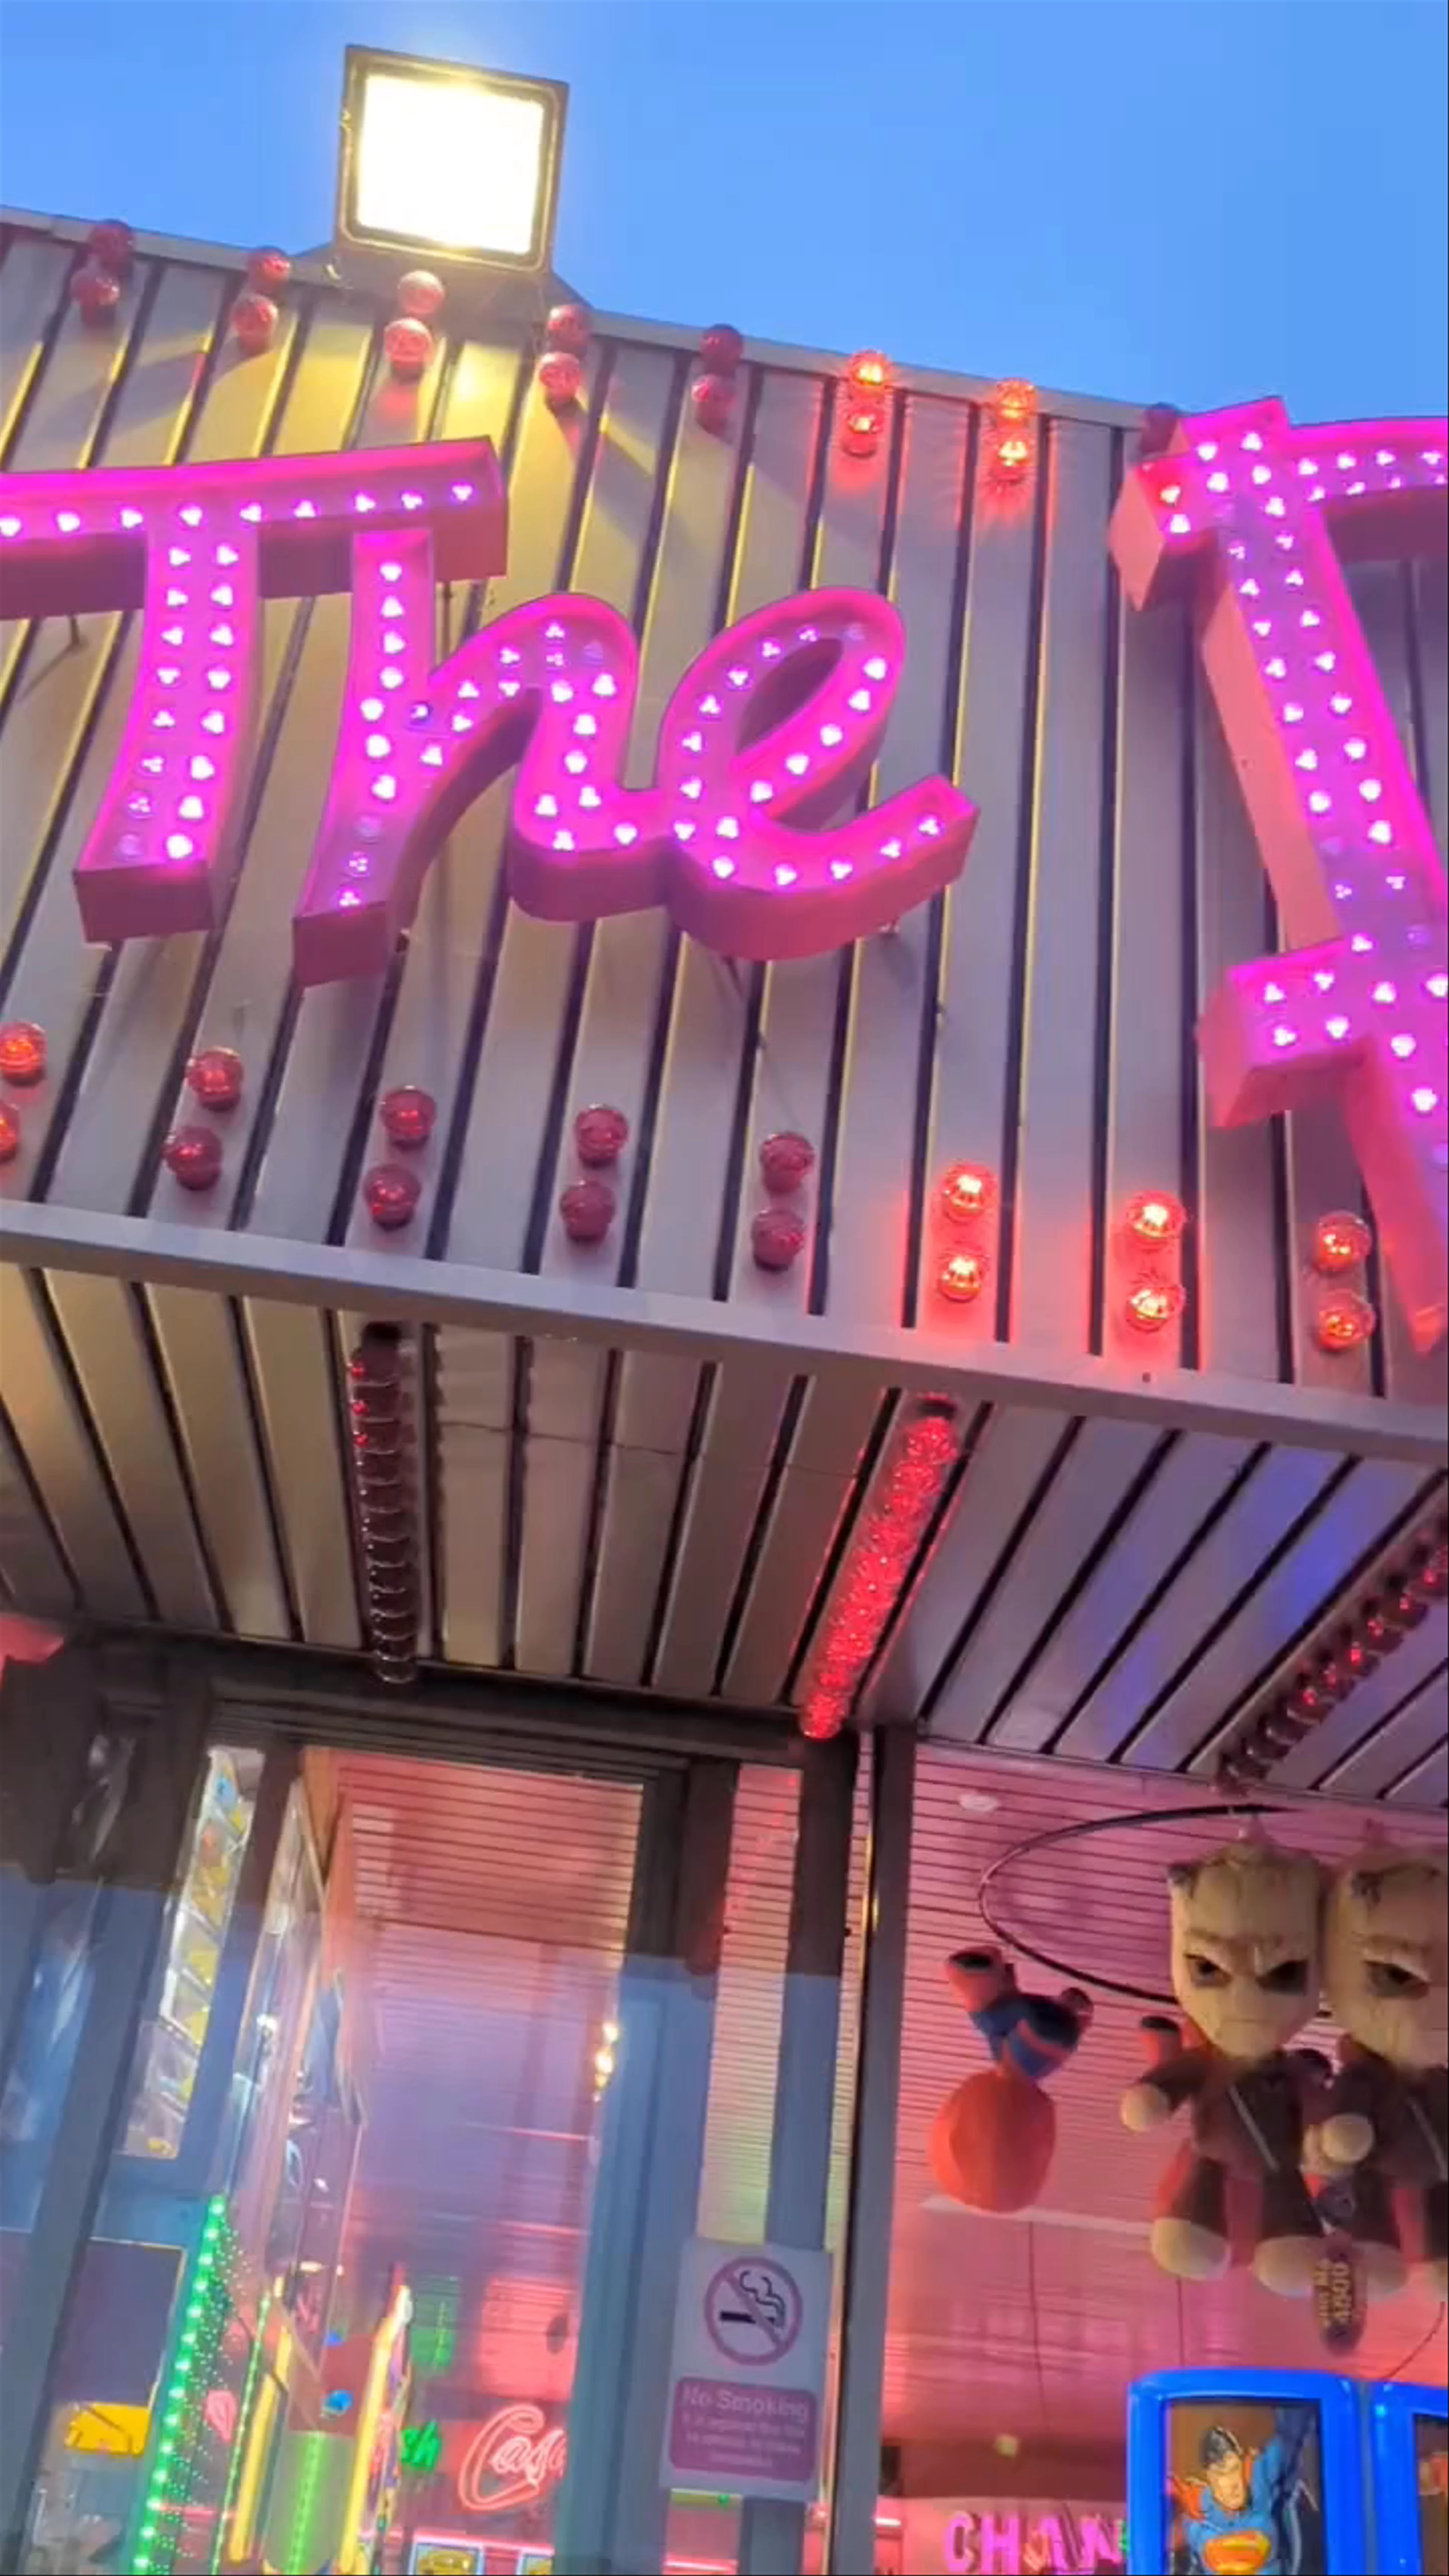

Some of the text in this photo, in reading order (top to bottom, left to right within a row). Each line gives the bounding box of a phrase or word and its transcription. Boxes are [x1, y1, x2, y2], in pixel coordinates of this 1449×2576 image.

[0, 436, 980, 989] The
[682, 2383, 712, 2407] No
[717, 2388, 808, 2425] Smoking
